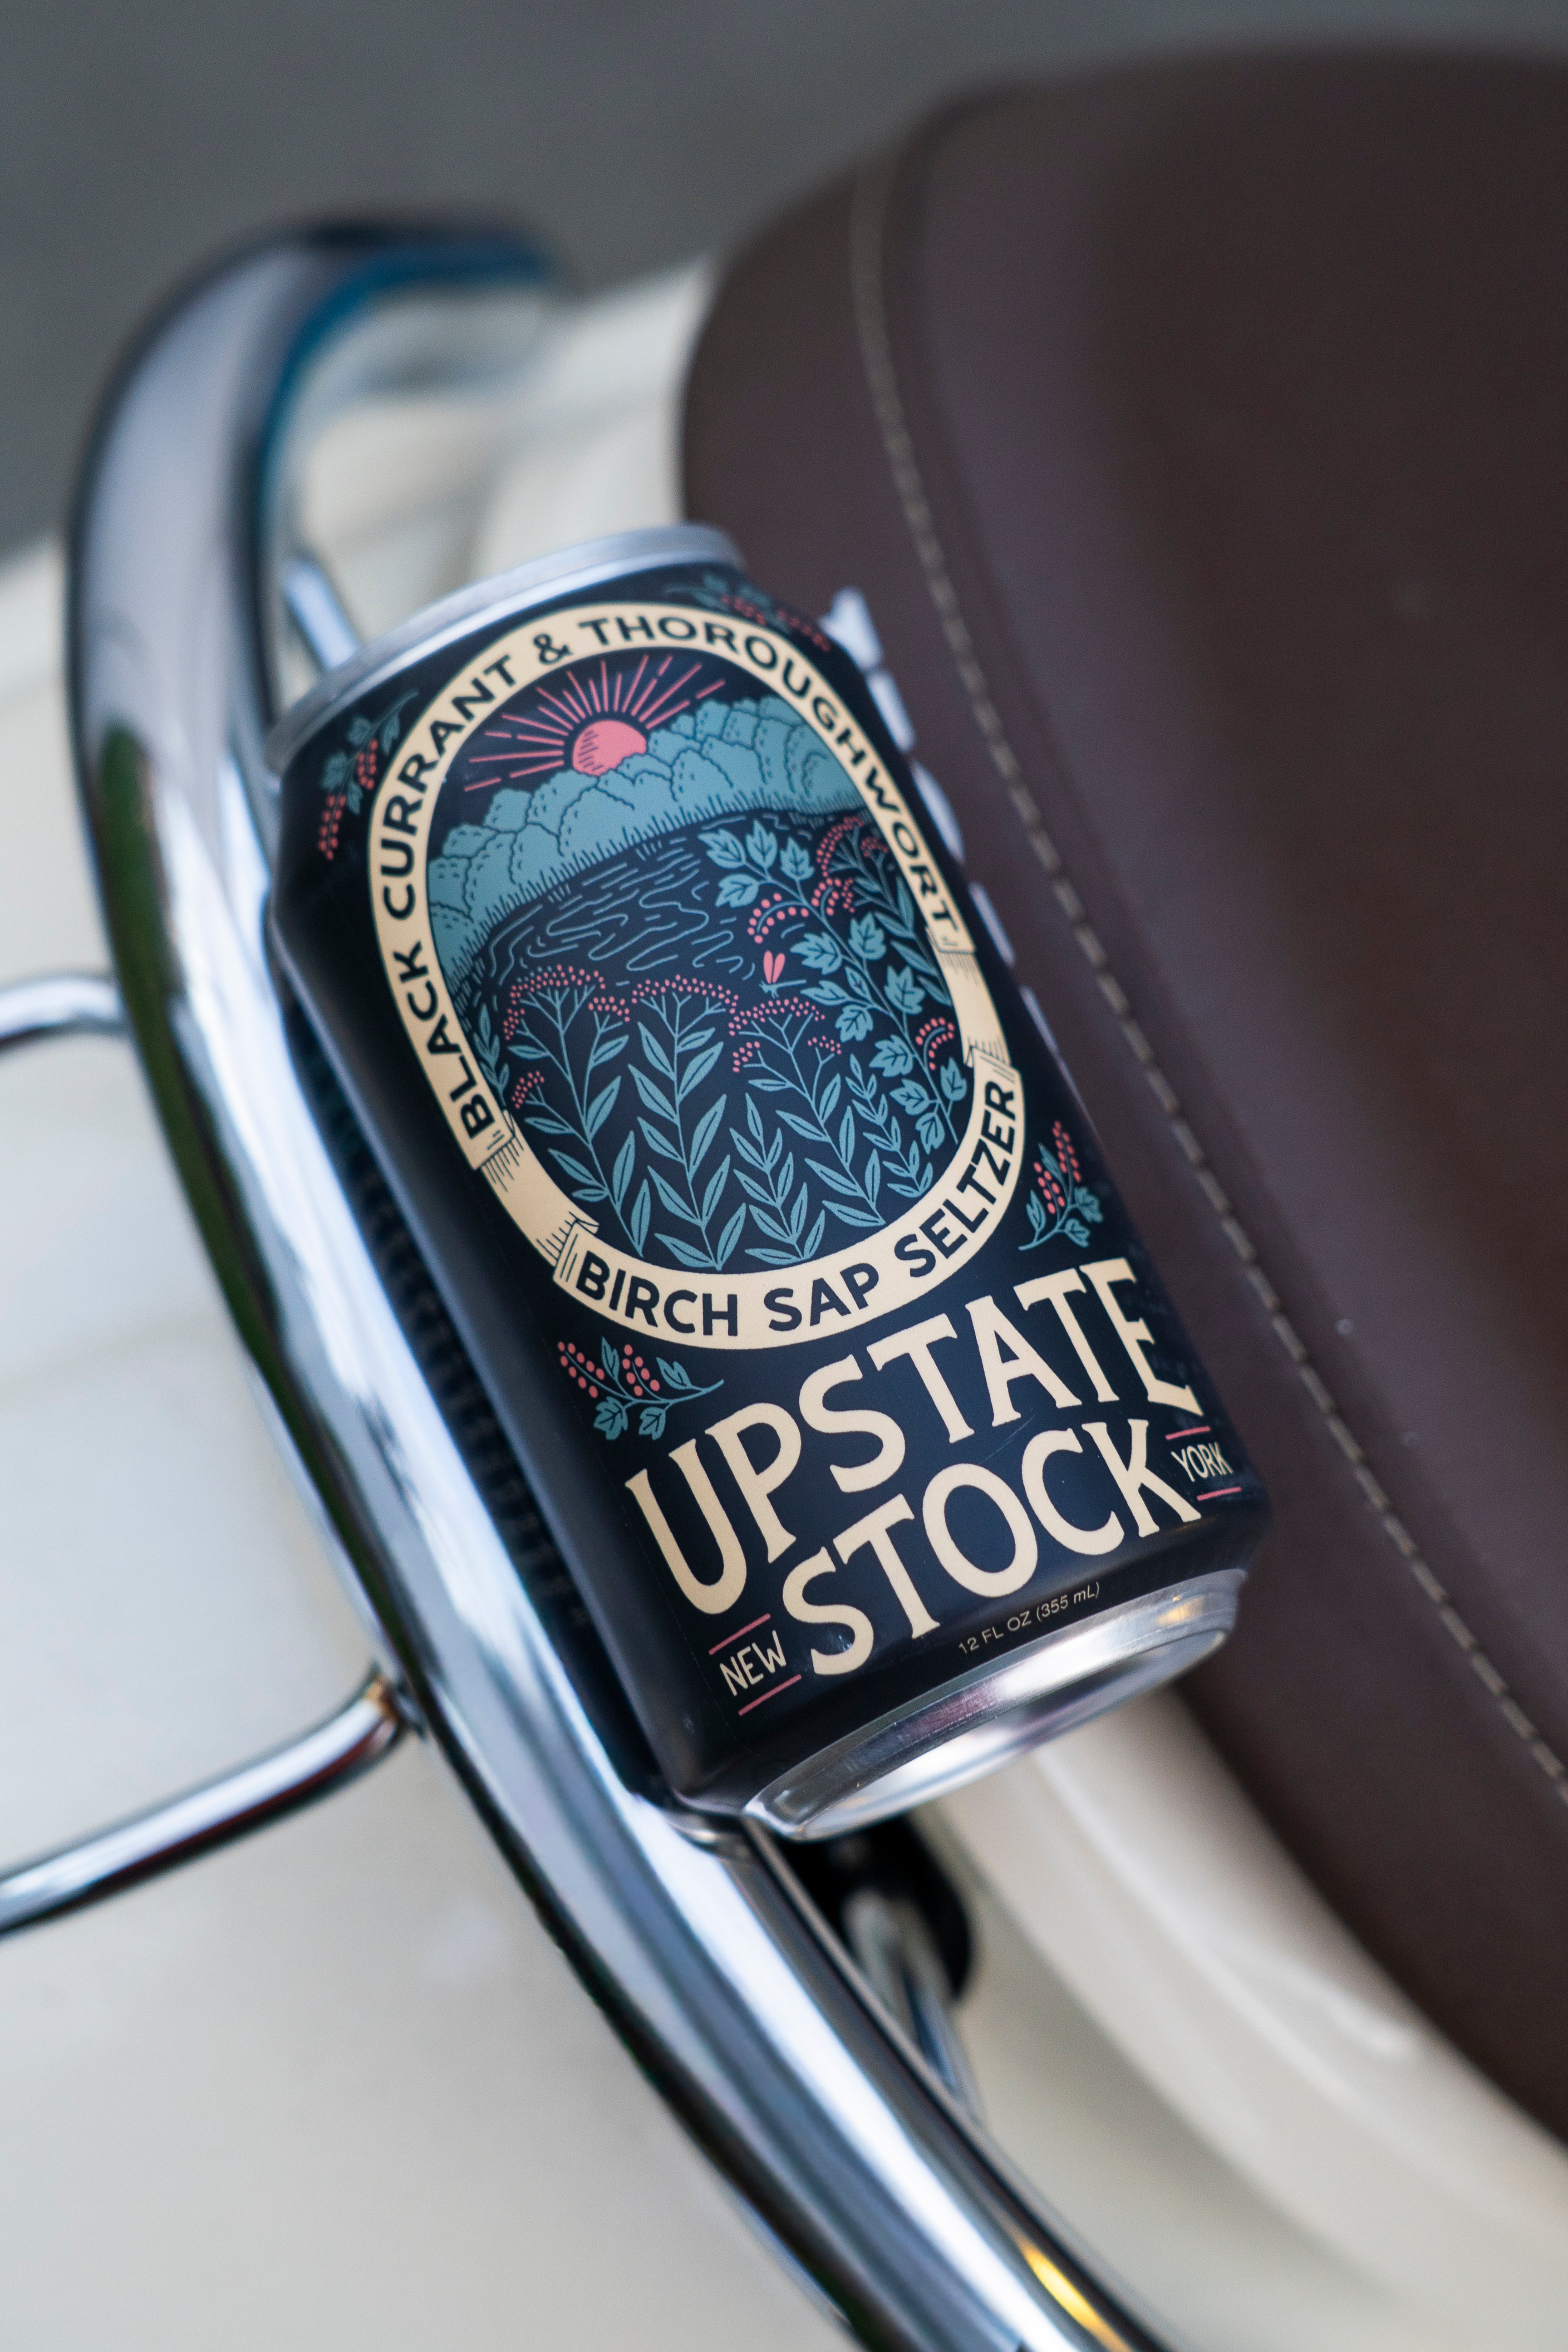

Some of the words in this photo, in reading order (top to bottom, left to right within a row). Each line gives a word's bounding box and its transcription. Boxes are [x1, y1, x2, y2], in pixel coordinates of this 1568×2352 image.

[533, 633, 573, 666] &
[380, 655, 517, 921] CURRANT
[578, 616, 958, 932] THOROUGHWORT
[393, 941, 495, 1139] BLACK
[575, 1251, 738, 1336] BIRCH
[763, 1262, 880, 1331] SAP
[894, 1080, 1018, 1277] SELTZER
[624, 1257, 1204, 1615] UPSTATE
[782, 1419, 1202, 1676] STOCK
[1170, 1441, 1234, 1482] YORK
[719, 1630, 787, 1696] NEW
[958, 1636, 979, 1654] 12
[981, 1626, 1004, 1644] FL
[1007, 1610, 1032, 1632] OZ
[1036, 1595, 1068, 1622] (355
[1073, 1581, 1100, 1605] mL)
